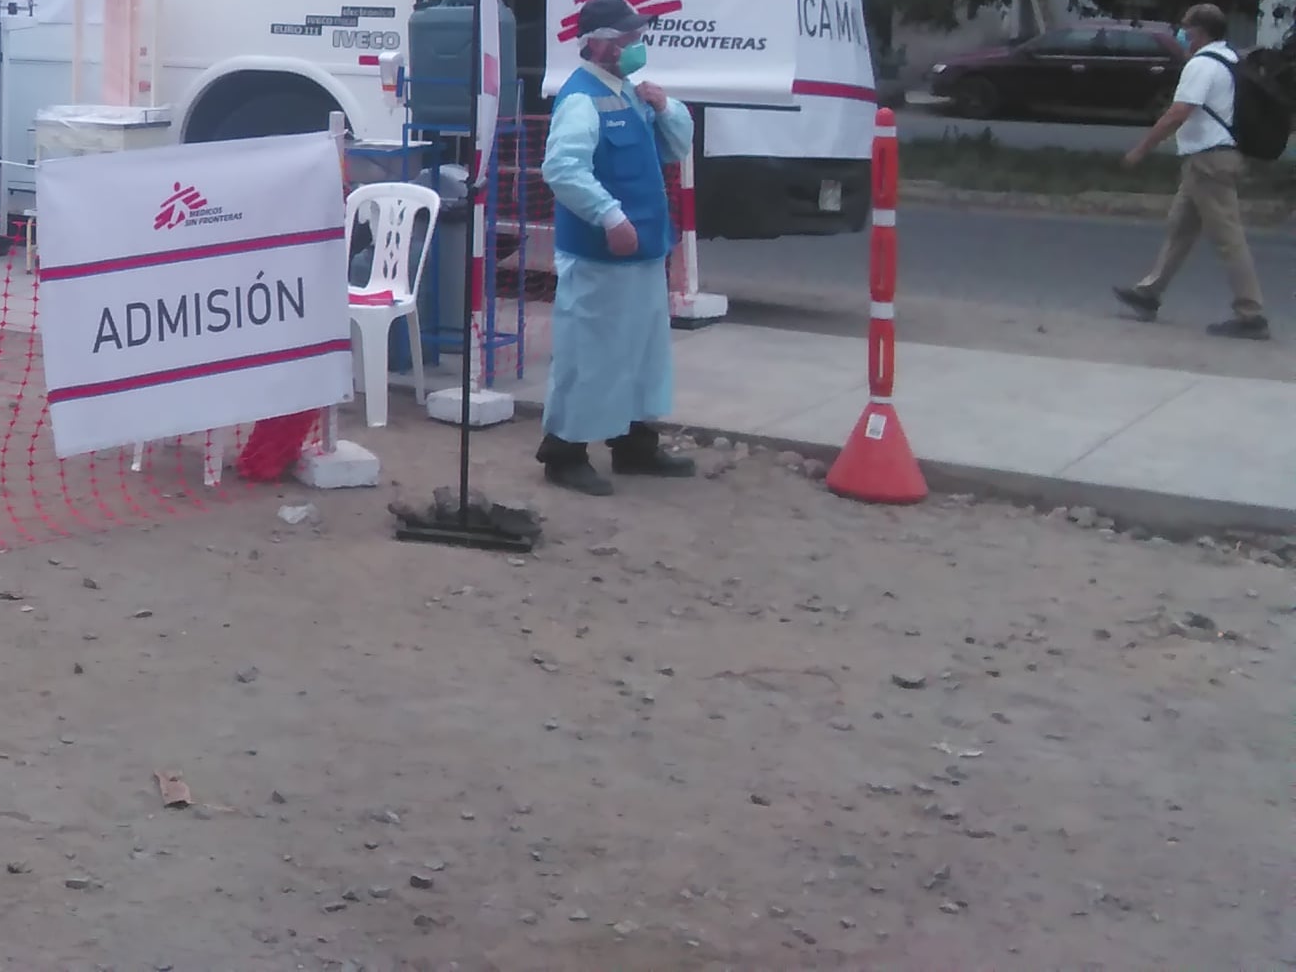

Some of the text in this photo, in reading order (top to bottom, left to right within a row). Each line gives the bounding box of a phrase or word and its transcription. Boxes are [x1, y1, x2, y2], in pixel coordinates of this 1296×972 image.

[332, 29, 401, 50] IVECO
[655, 34, 768, 51] FRONTERAS
[92, 270, 305, 354] ADMISIÓN
